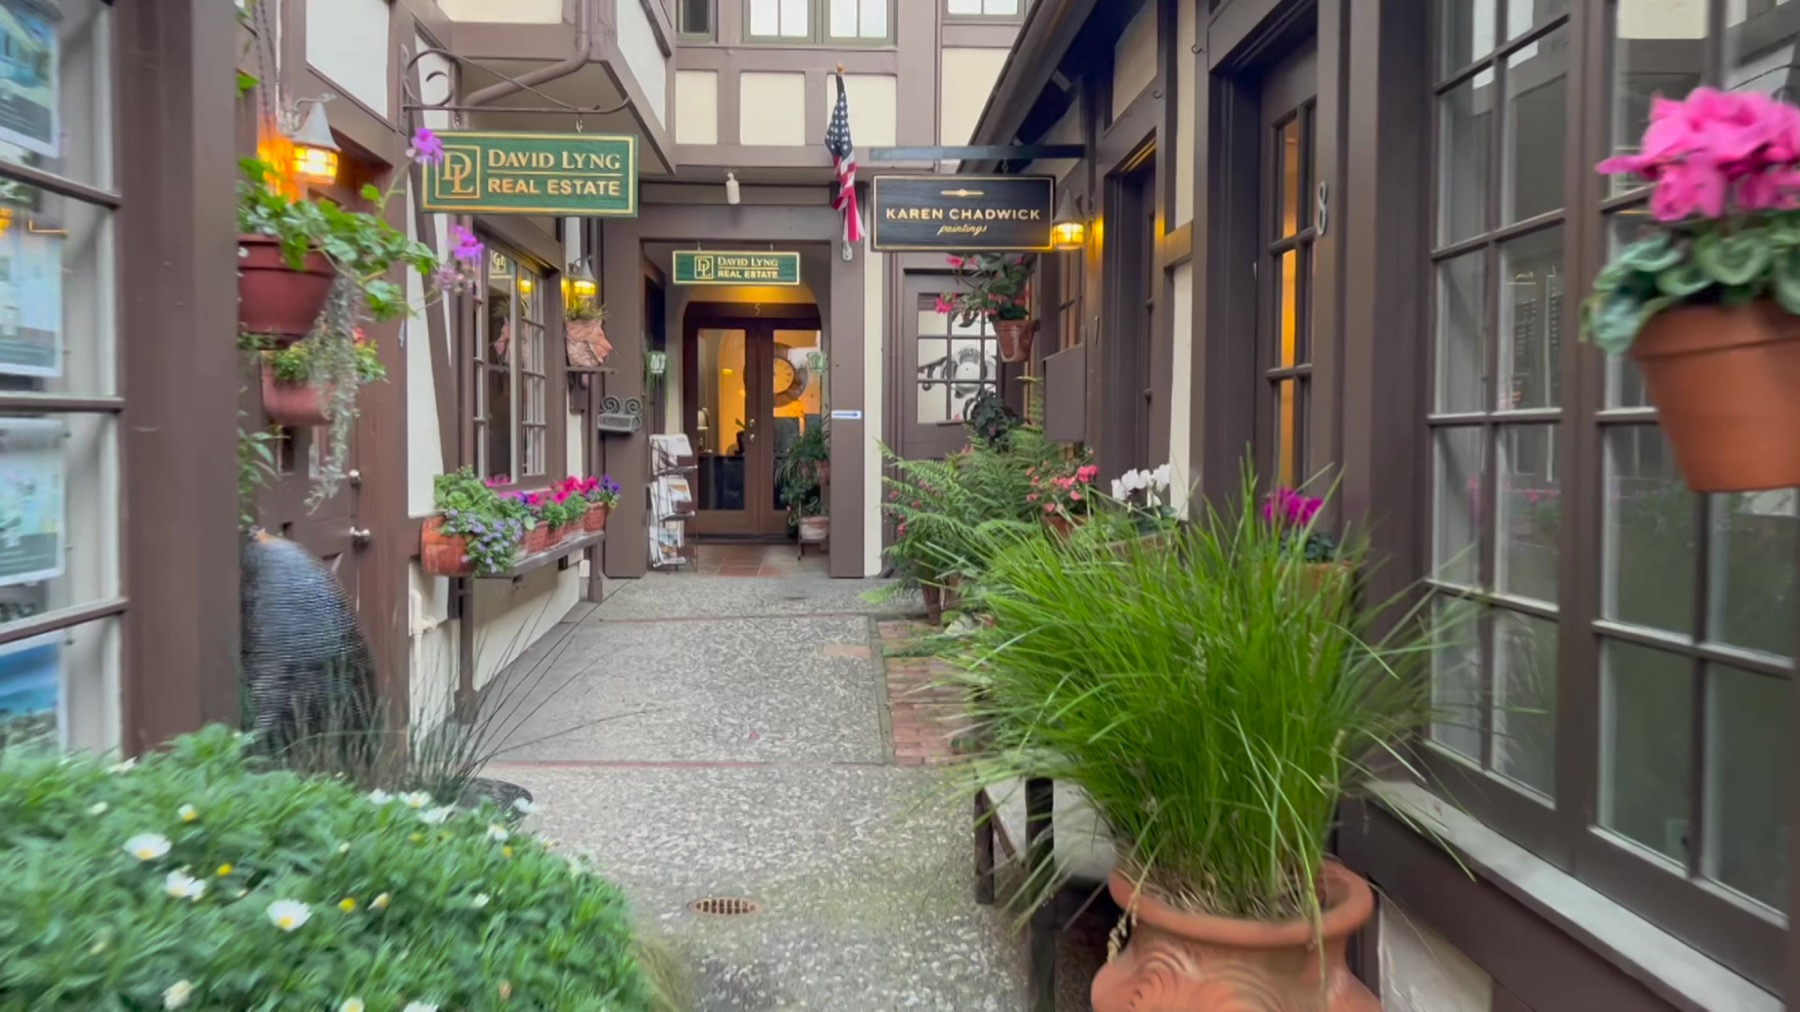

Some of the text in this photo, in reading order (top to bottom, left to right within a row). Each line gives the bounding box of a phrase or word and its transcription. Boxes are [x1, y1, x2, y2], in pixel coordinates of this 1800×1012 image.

[487, 149, 621, 170] DAVID LYNG
[487, 178, 620, 196] REAL ESTATE
[886, 207, 1040, 220] KAREN CHADWICK
[1314, 181, 1327, 236] 8
[936, 224, 988, 236] paintings
[718, 257, 778, 267] DAVID LYNG
[718, 269, 778, 279] REAL ESTATE
